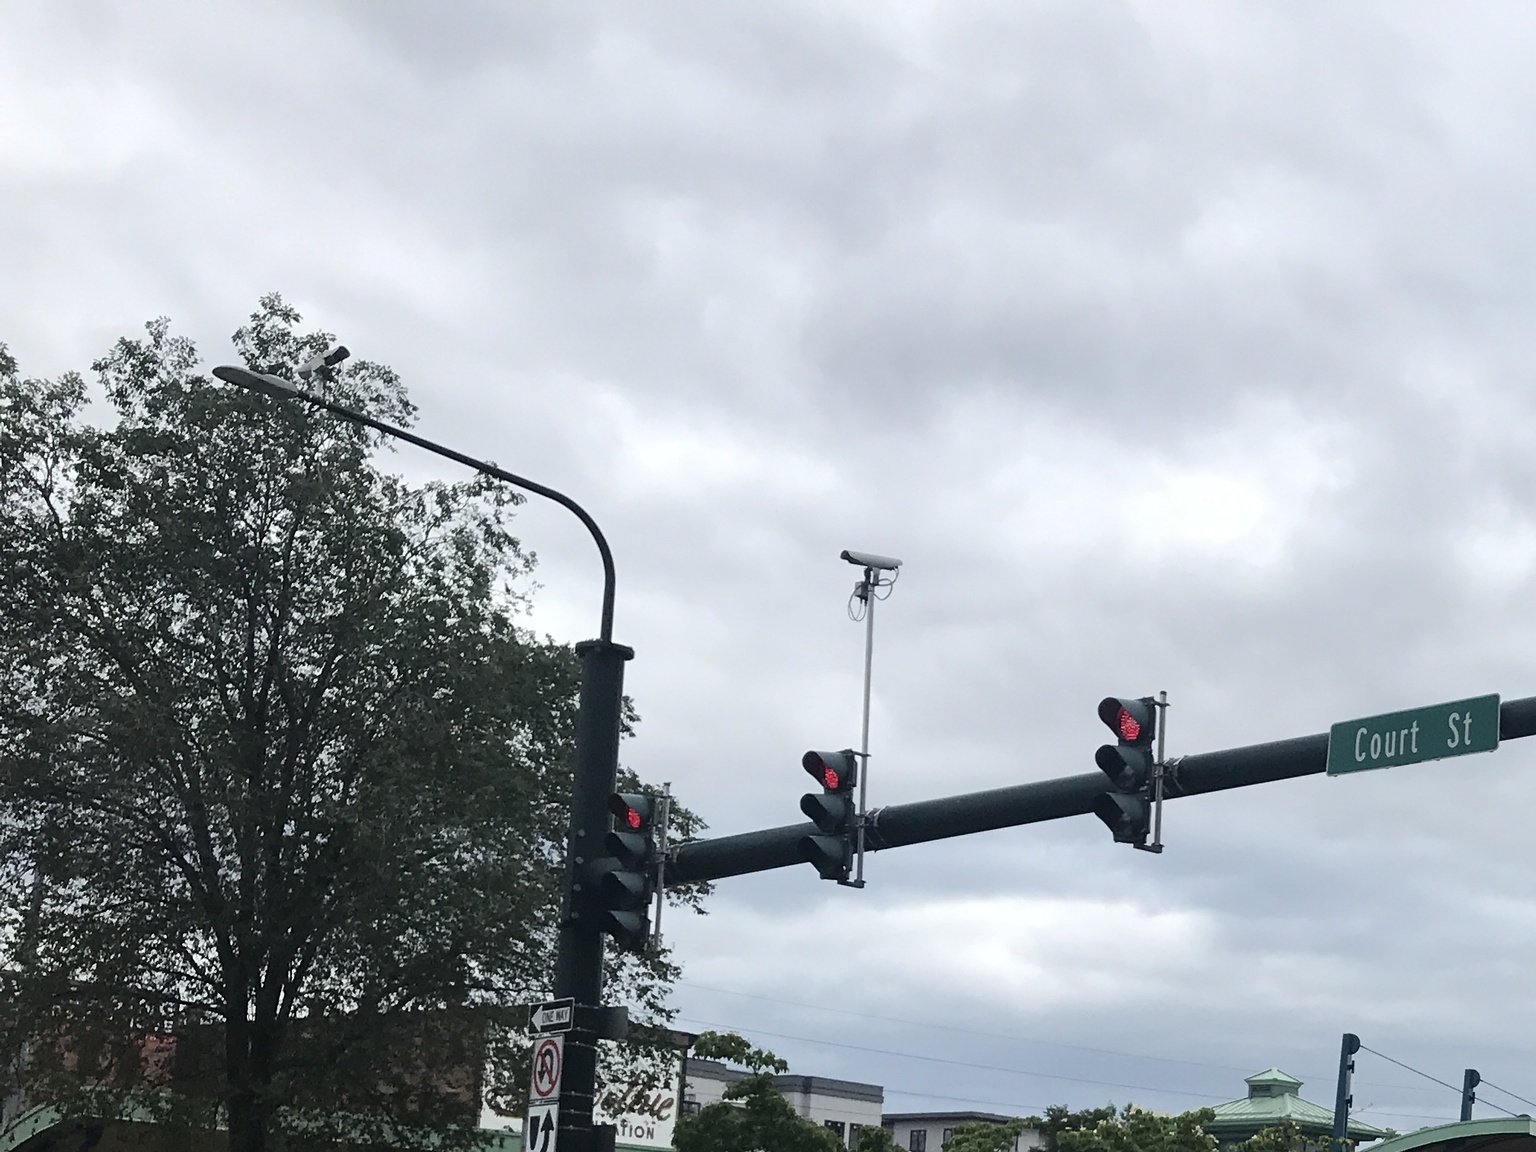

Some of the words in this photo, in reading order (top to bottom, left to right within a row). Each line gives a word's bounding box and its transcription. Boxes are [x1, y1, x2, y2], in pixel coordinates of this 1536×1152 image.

[1355, 720, 1419, 762] Court
[1447, 712, 1473, 748] St
[543, 1011, 554, 1023] ONE
[556, 1008, 570, 1022] WAY
